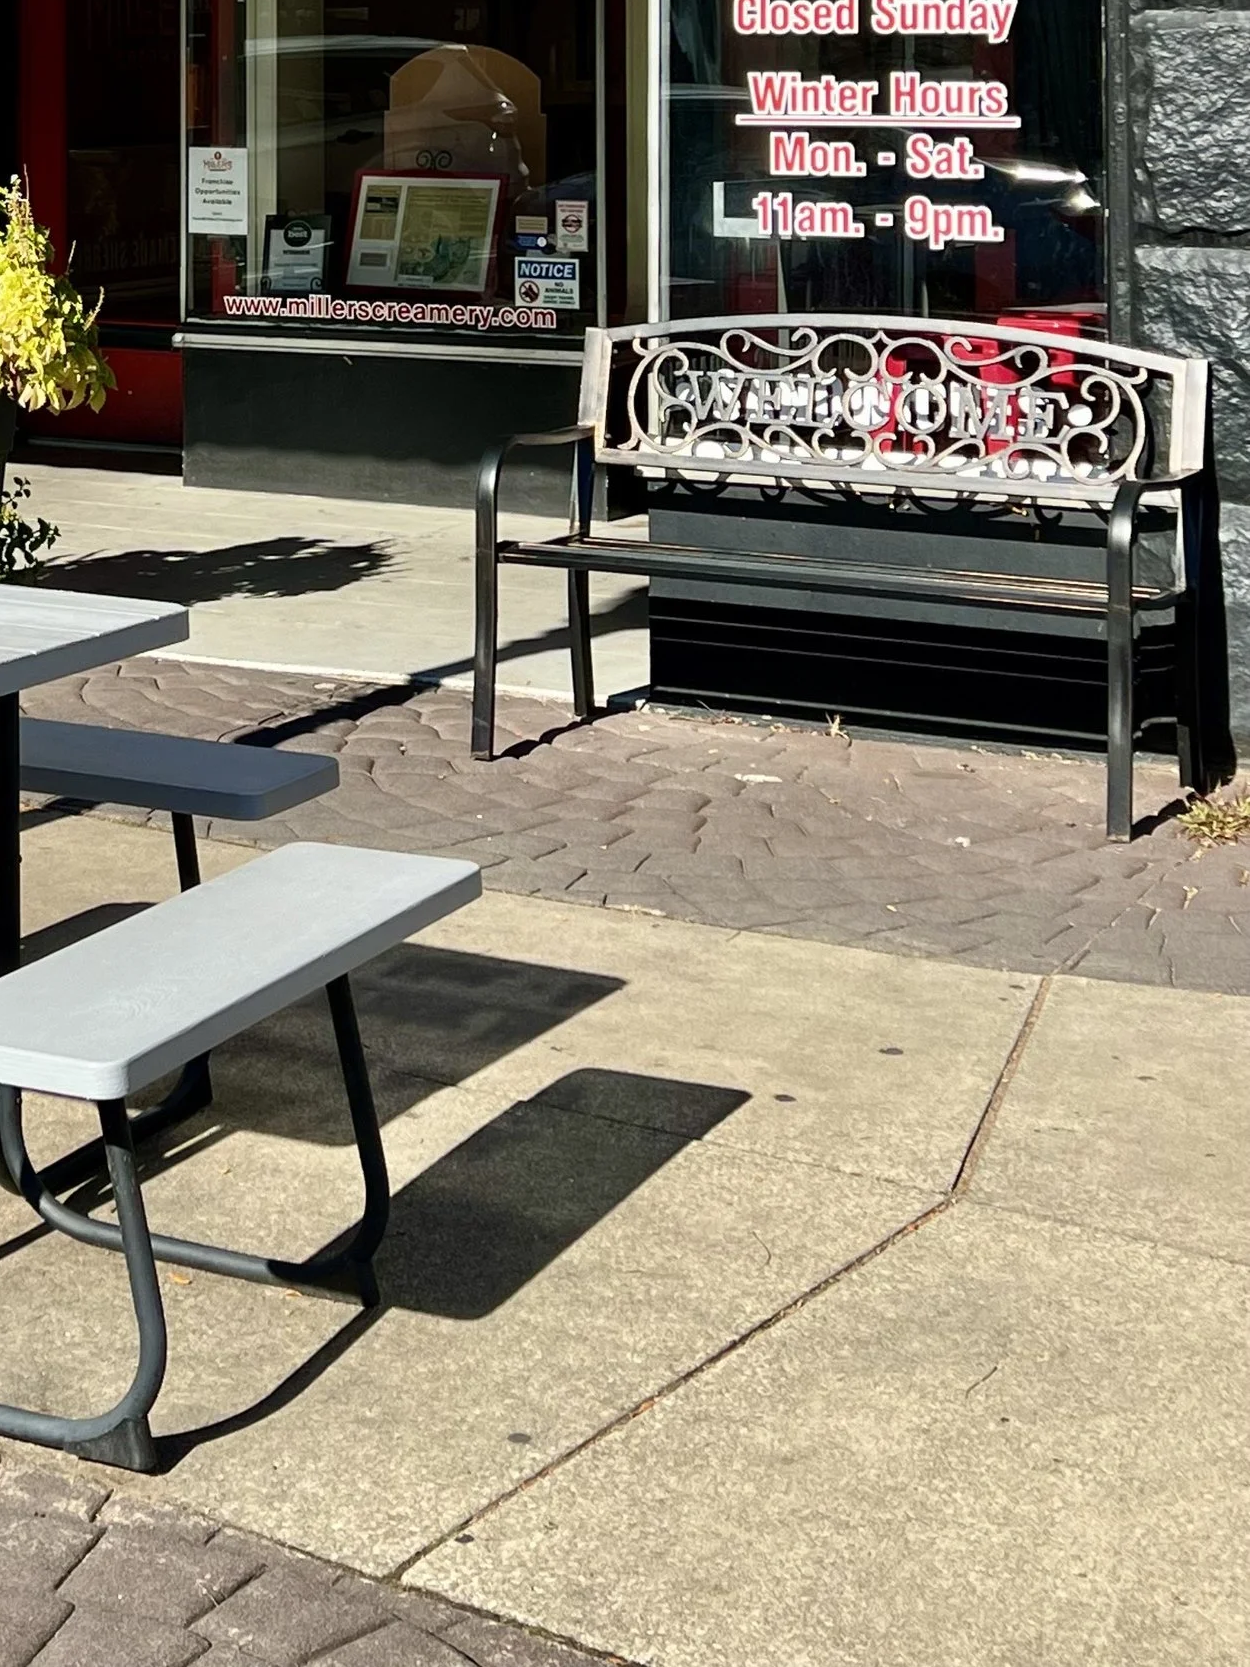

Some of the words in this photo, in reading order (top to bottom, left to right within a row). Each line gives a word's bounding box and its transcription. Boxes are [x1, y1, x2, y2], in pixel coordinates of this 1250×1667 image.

[747, 71, 879, 117] Winter
[889, 71, 1009, 116] Hours
[769, 131, 867, 178] Mon.
[906, 133, 986, 180] Sat.
[194, 187, 241, 196] Opportunities
[752, 191, 865, 239] 11am.
[904, 194, 1005, 251] 9pm.
[519, 262, 574, 279] NOTICE
[223, 293, 557, 330] www.millerscreamery.com
[677, 368, 1070, 445] WELCOME
